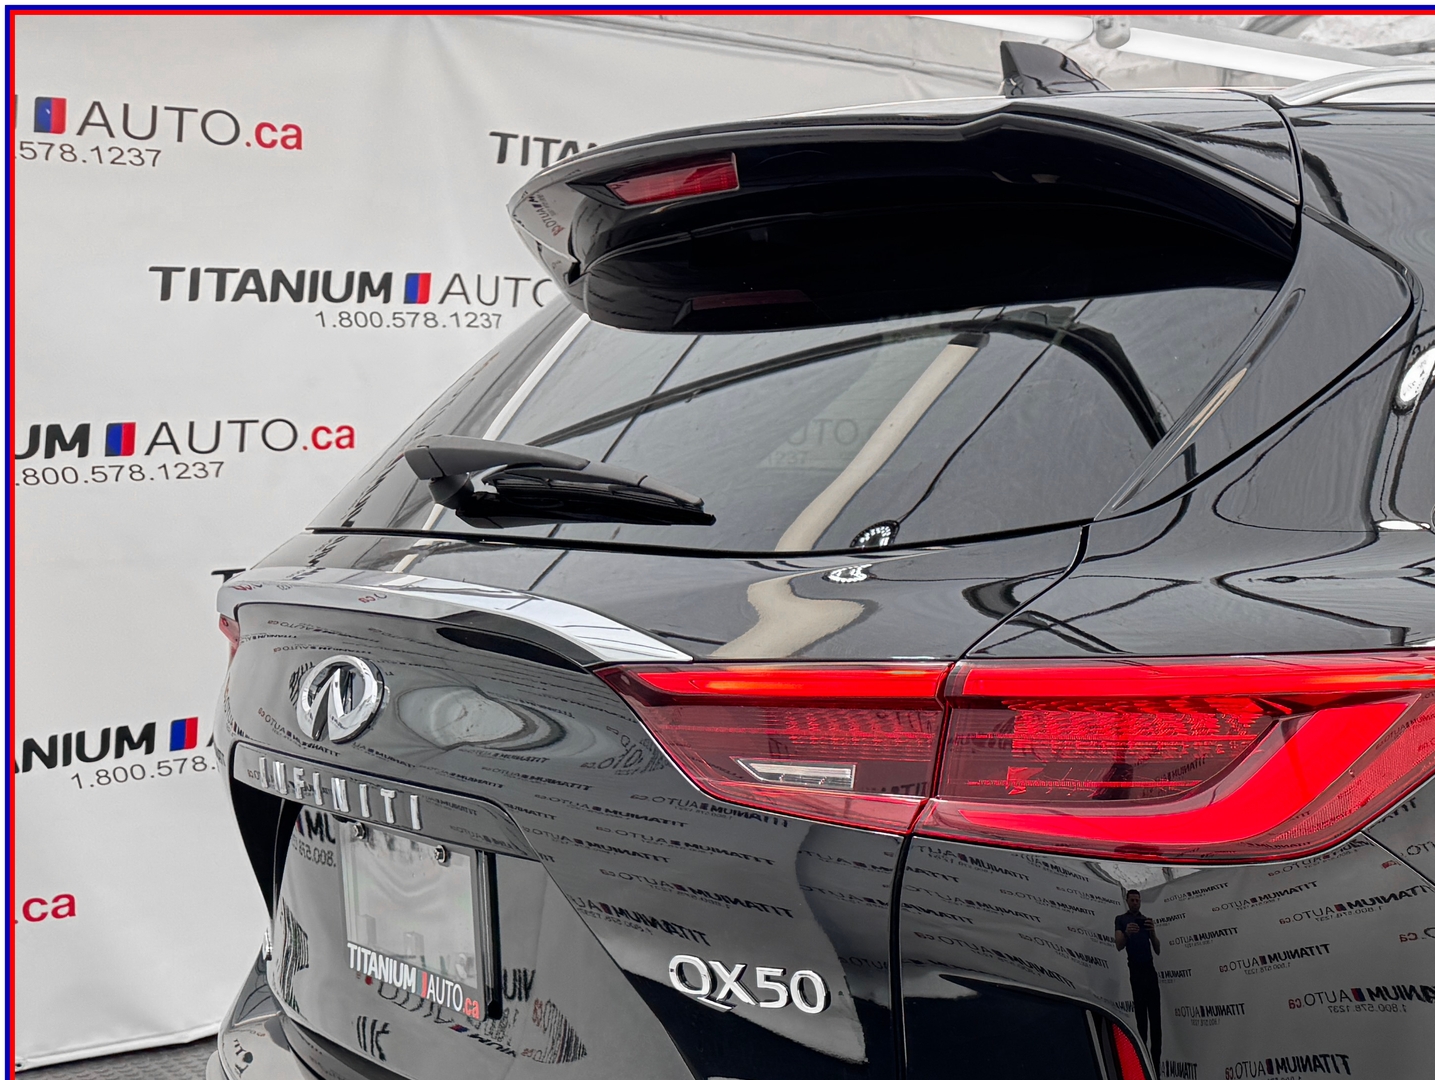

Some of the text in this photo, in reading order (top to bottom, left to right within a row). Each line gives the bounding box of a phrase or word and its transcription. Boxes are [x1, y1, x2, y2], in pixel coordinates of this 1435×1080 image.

[76, 100, 303, 150] AUTO.ca
[15, 140, 162, 168] 578.1237
[489, 131, 598, 168] TITA
[148, 266, 393, 303] TITANIUM
[315, 311, 502, 329] 1.800.578.1237
[145, 419, 355, 456] AUTO.ca
[15, 722, 156, 774] NIUM
[258, 756, 421, 830] INFINITI
[346, 943, 480, 1019] TITANIUM AUTO.ca
[669, 955, 828, 1014] QX50
